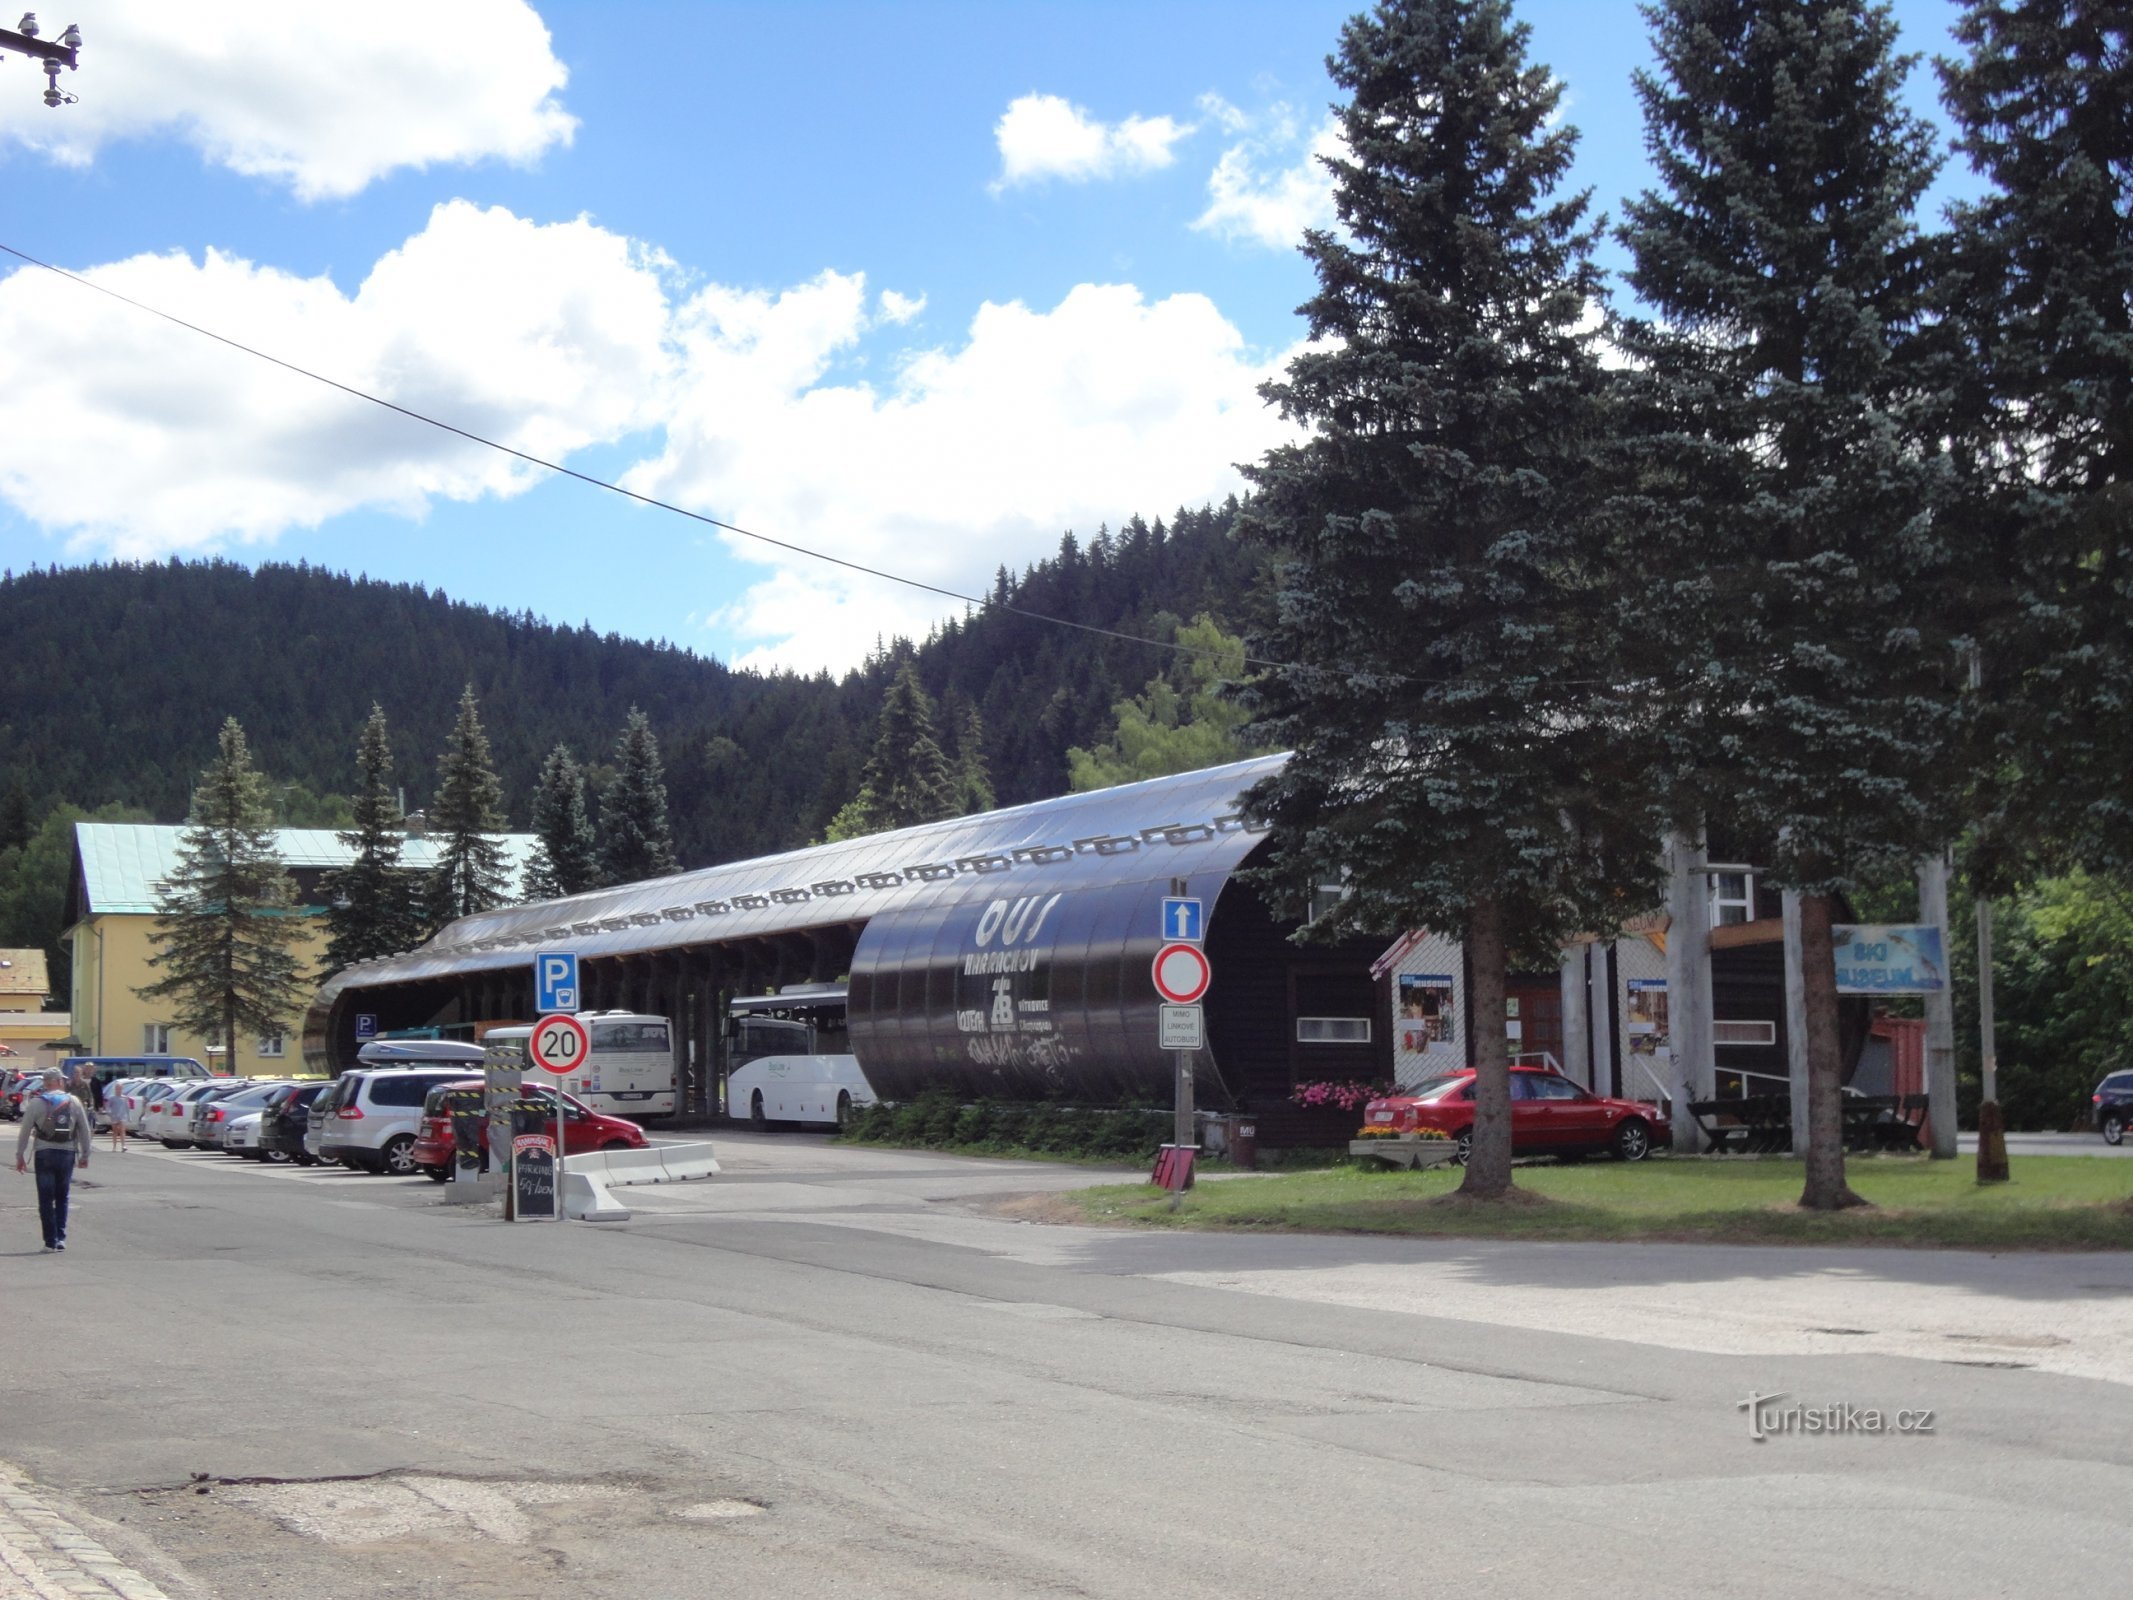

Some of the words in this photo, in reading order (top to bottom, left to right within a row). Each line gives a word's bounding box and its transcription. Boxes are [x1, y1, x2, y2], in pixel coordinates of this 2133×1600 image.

[1854, 943, 1887, 961] SKI
[964, 949, 1039, 975] HARRACHOV
[545, 959, 569, 993] P
[359, 1016, 371, 1031] P
[1167, 1022, 1196, 1031] LINKOVÉ
[543, 1030, 575, 1057] 20
[1164, 1035, 1198, 1043] AUTOBUSY
